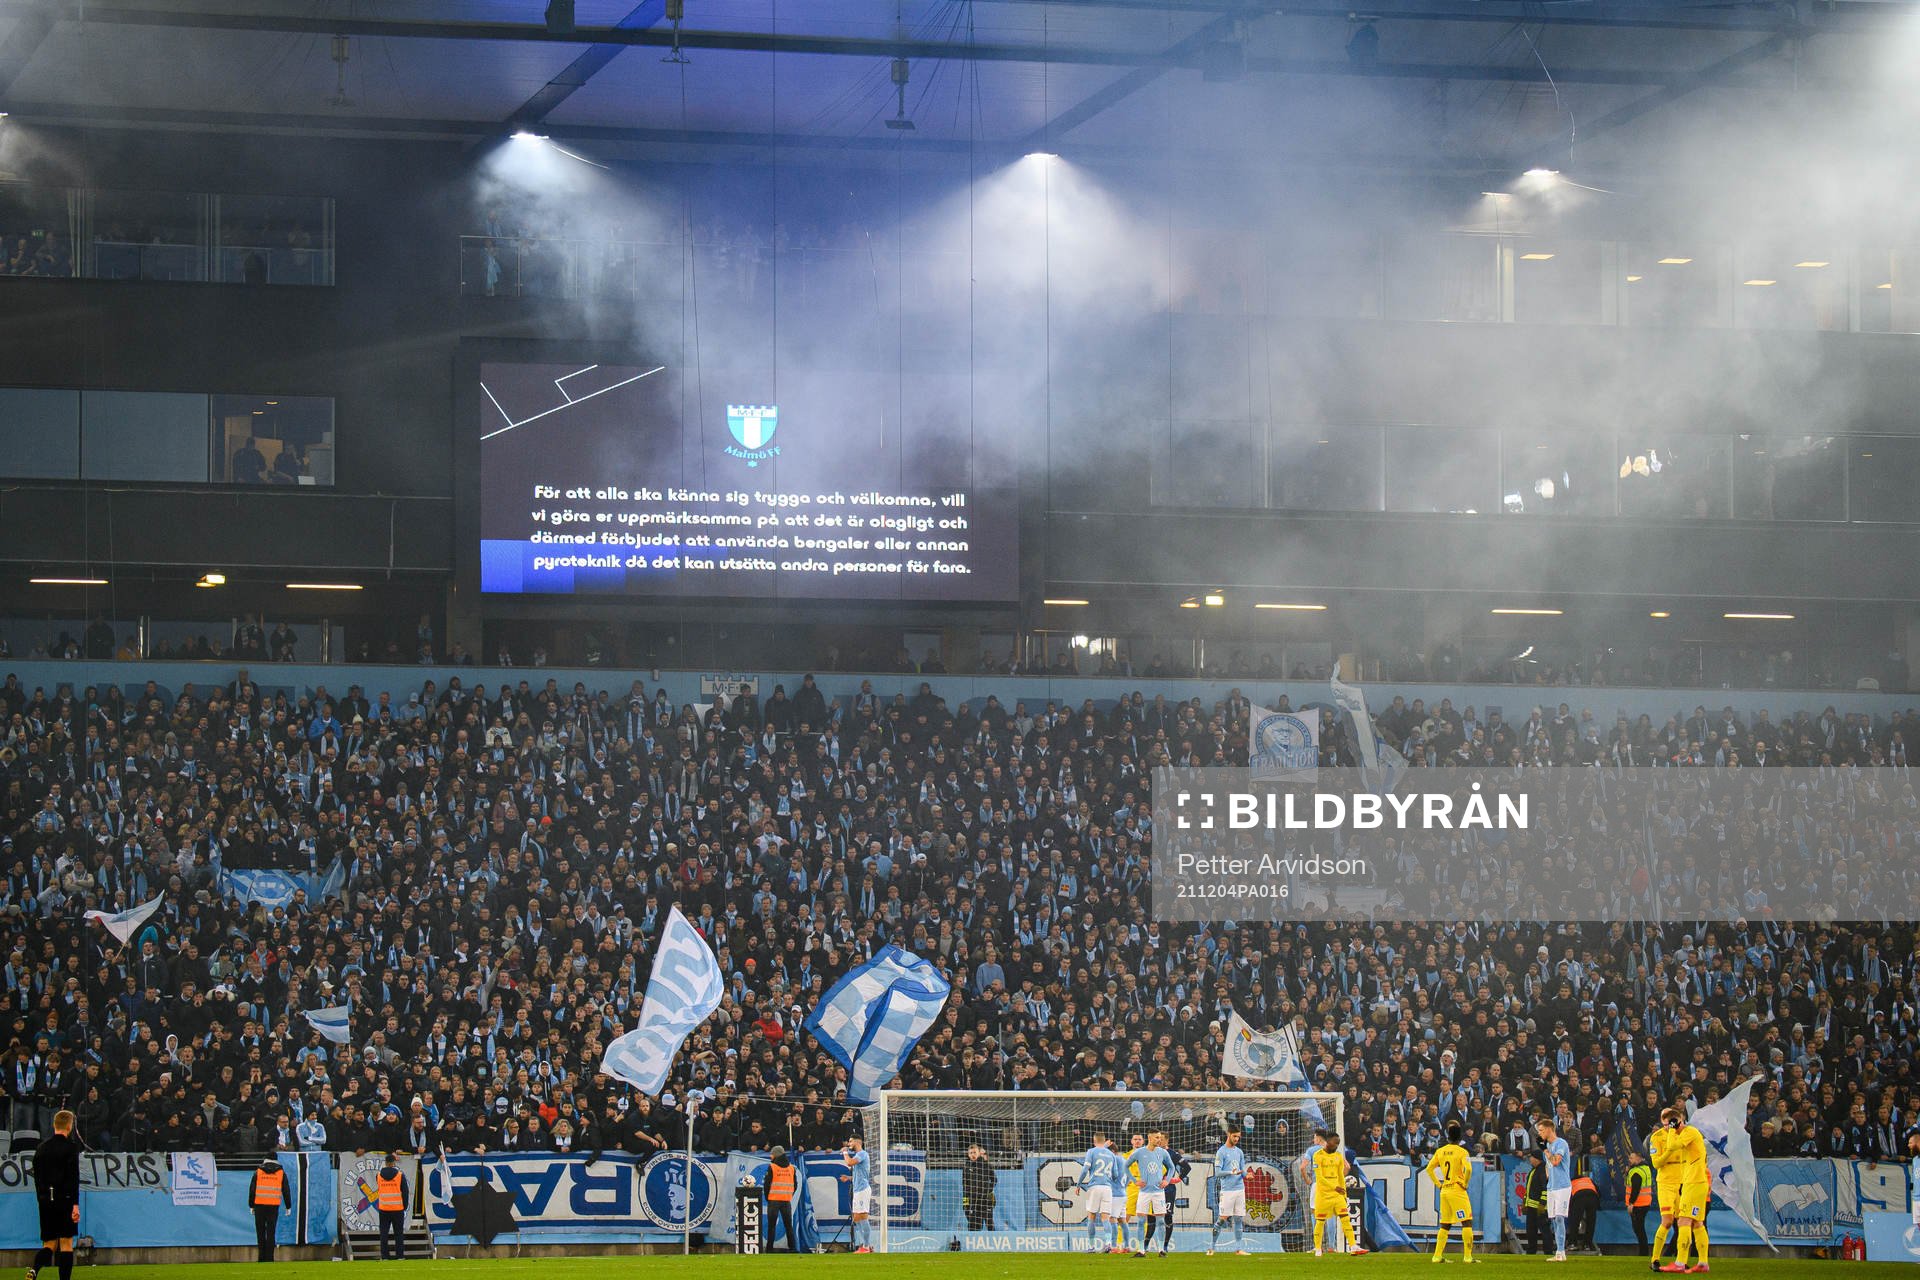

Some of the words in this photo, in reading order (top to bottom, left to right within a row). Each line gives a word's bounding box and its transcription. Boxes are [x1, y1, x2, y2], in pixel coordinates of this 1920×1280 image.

[534, 484, 561, 499] För
[565, 486, 591, 500] att
[595, 486, 629, 501] alla
[633, 487, 663, 501] ska
[667, 487, 720, 502] känna
[725, 490, 749, 507] sig
[753, 491, 811, 508] trygga
[816, 491, 845, 505] och
[849, 491, 937, 508] välkomna,
[940, 493, 965, 507] vill
[531, 508, 547, 522] vi
[550, 508, 591, 526] göra
[595, 513, 613, 523] er
[617, 510, 752, 527] uppmärksamma
[757, 513, 779, 529] på
[784, 514, 810, 527] att
[813, 513, 843, 527] det
[846, 514, 865, 528] är
[869, 514, 935, 533] olagligt
[938, 515, 968, 530] och
[530, 530, 596, 545] därmed
[600, 531, 681, 550] förbjudet
[685, 534, 711, 547] att
[714, 535, 789, 548] använda
[793, 535, 870, 553] bengaler
[873, 536, 912, 551] eller
[915, 540, 969, 552] annan
[533, 553, 622, 571] pyroteknik
[624, 554, 648, 569] då
[651, 555, 681, 569] det
[684, 555, 715, 570] kan
[719, 557, 777, 571] utsätta
[780, 557, 829, 572] andra
[833, 562, 903, 576] personer
[905, 559, 930, 574] för
[932, 559, 972, 574] fara.
[79, 1153, 160, 1187] TRAS
[1094, 1158, 1113, 1180] 24
[1444, 1160, 1451, 1181] 2
[743, 1196, 760, 1254] SELECT
[1776, 1221, 1831, 1236] MALMÖ
[1784, 1215, 1822, 1225] FRAMÅT
[965, 1236, 1012, 1251] HALVA
[1016, 1236, 1066, 1251] PRISET
